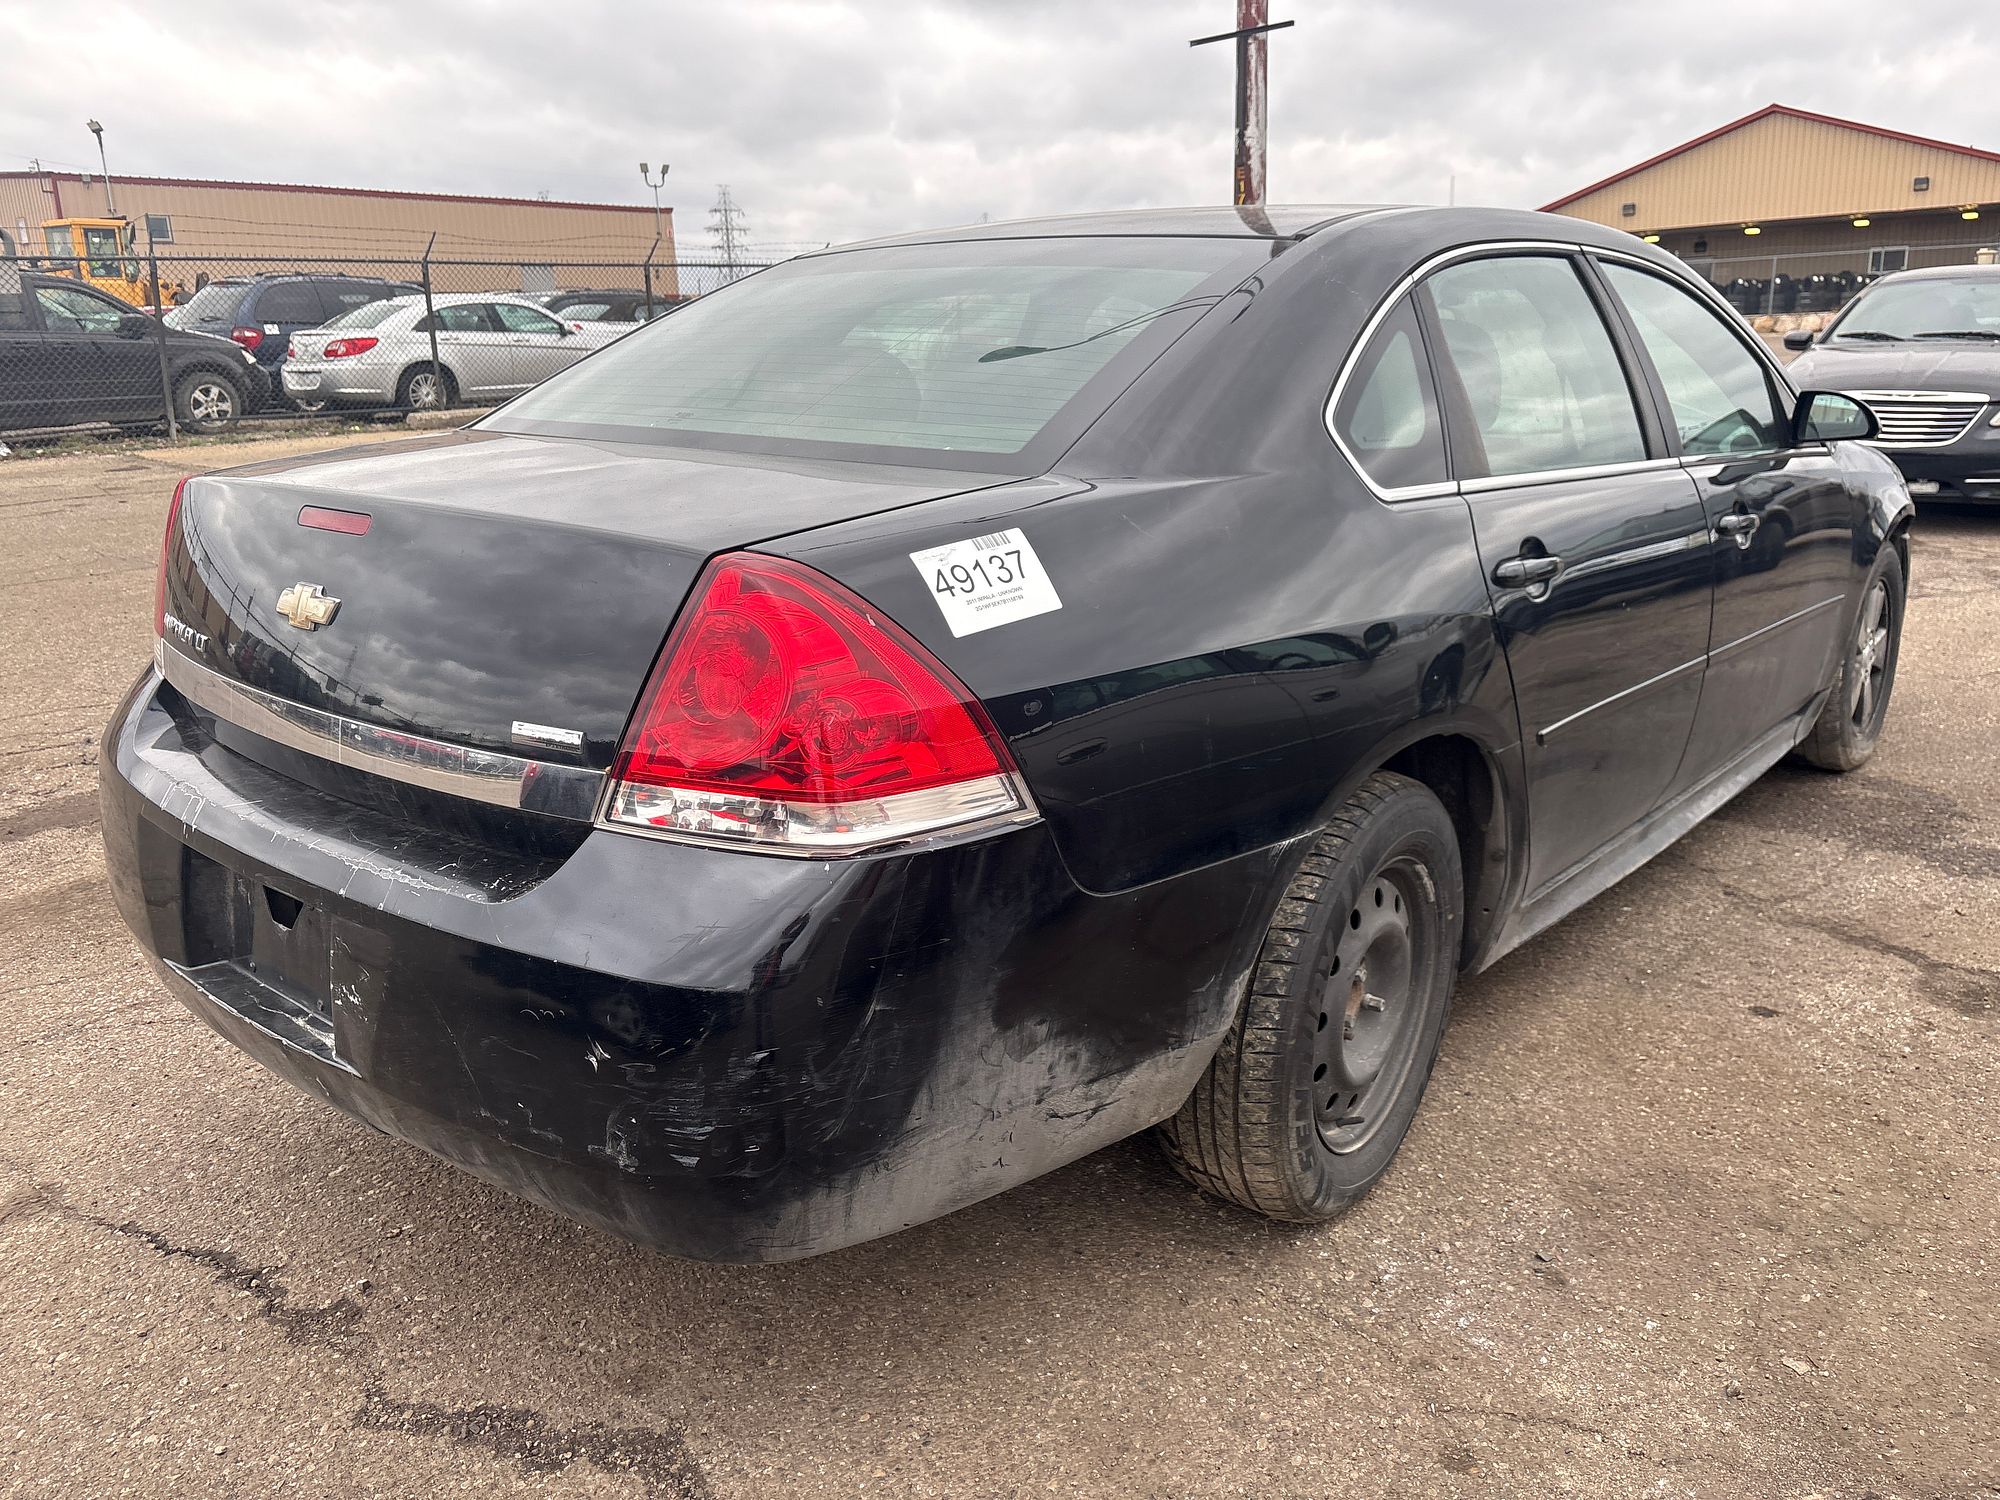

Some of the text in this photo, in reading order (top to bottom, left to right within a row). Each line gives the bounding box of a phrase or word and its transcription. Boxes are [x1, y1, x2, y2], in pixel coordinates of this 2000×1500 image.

[935, 549, 1026, 597] 49137
[977, 593, 995, 603] IMPALA
[998, 586, 1023, 597] UNKNOWN
